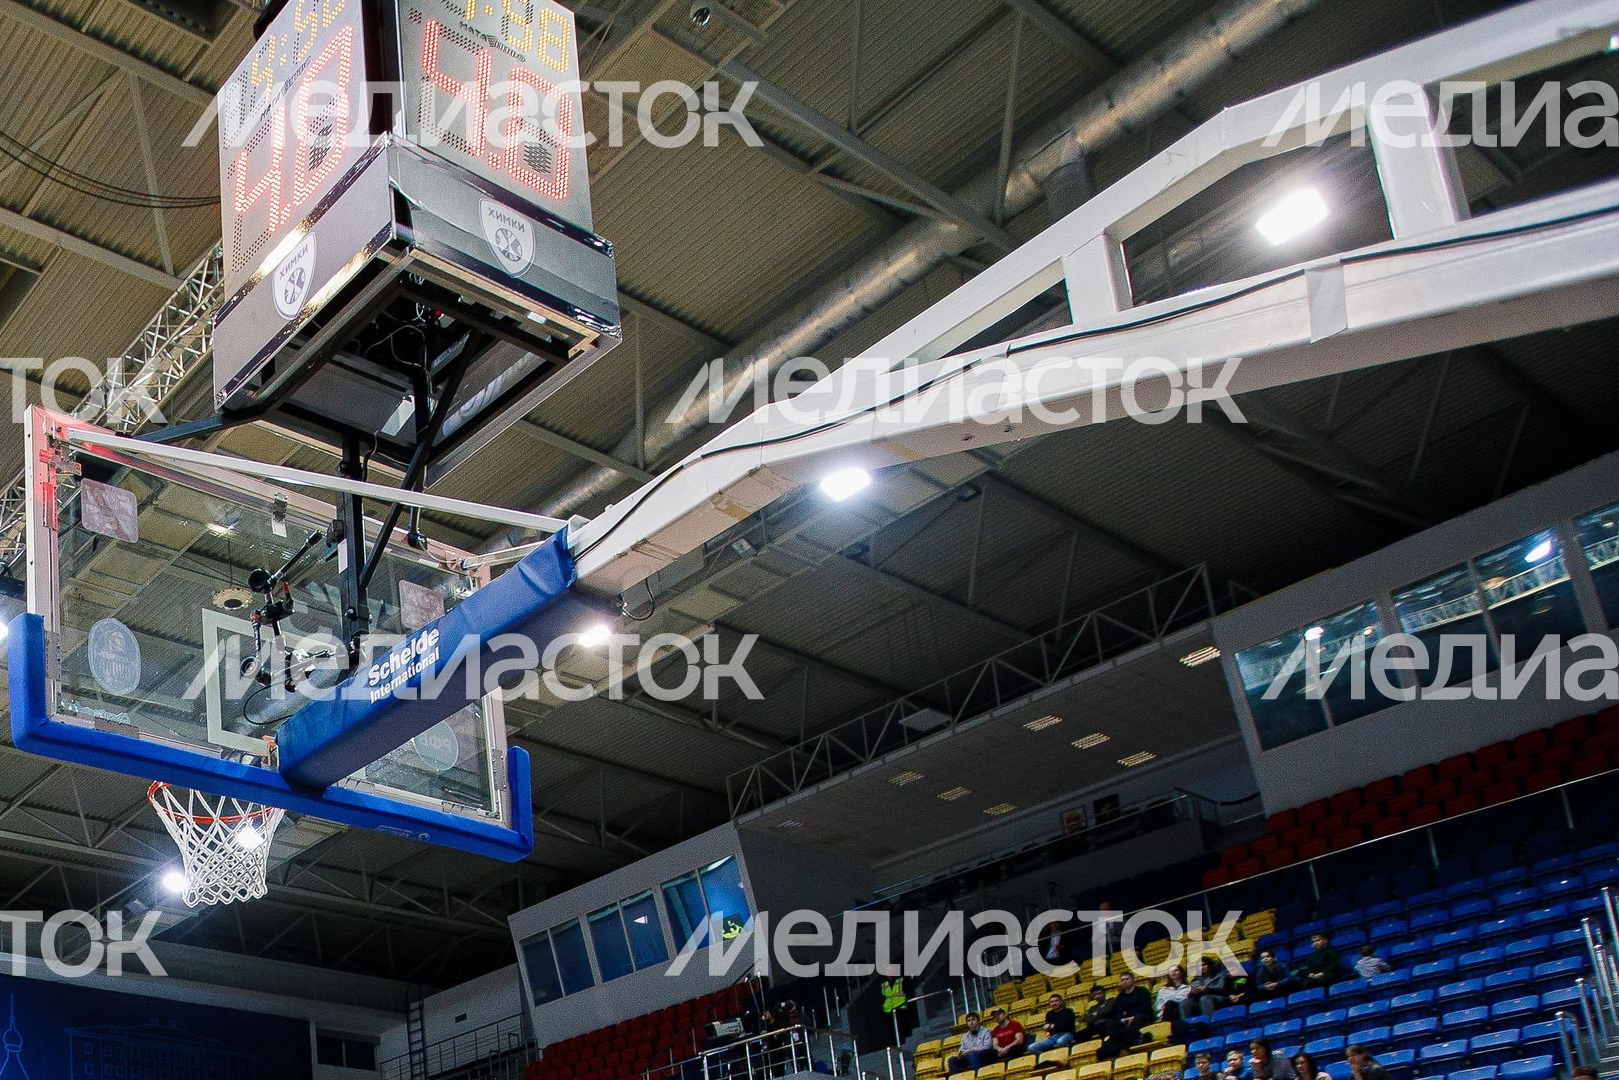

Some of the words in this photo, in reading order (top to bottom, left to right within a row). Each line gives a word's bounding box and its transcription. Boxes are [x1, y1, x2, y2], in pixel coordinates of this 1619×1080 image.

[488, 207, 525, 233] ХИМКИ
[279, 243, 308, 281] ХИМКИ
[368, 627, 440, 687] Schelde
[370, 647, 440, 705] International
